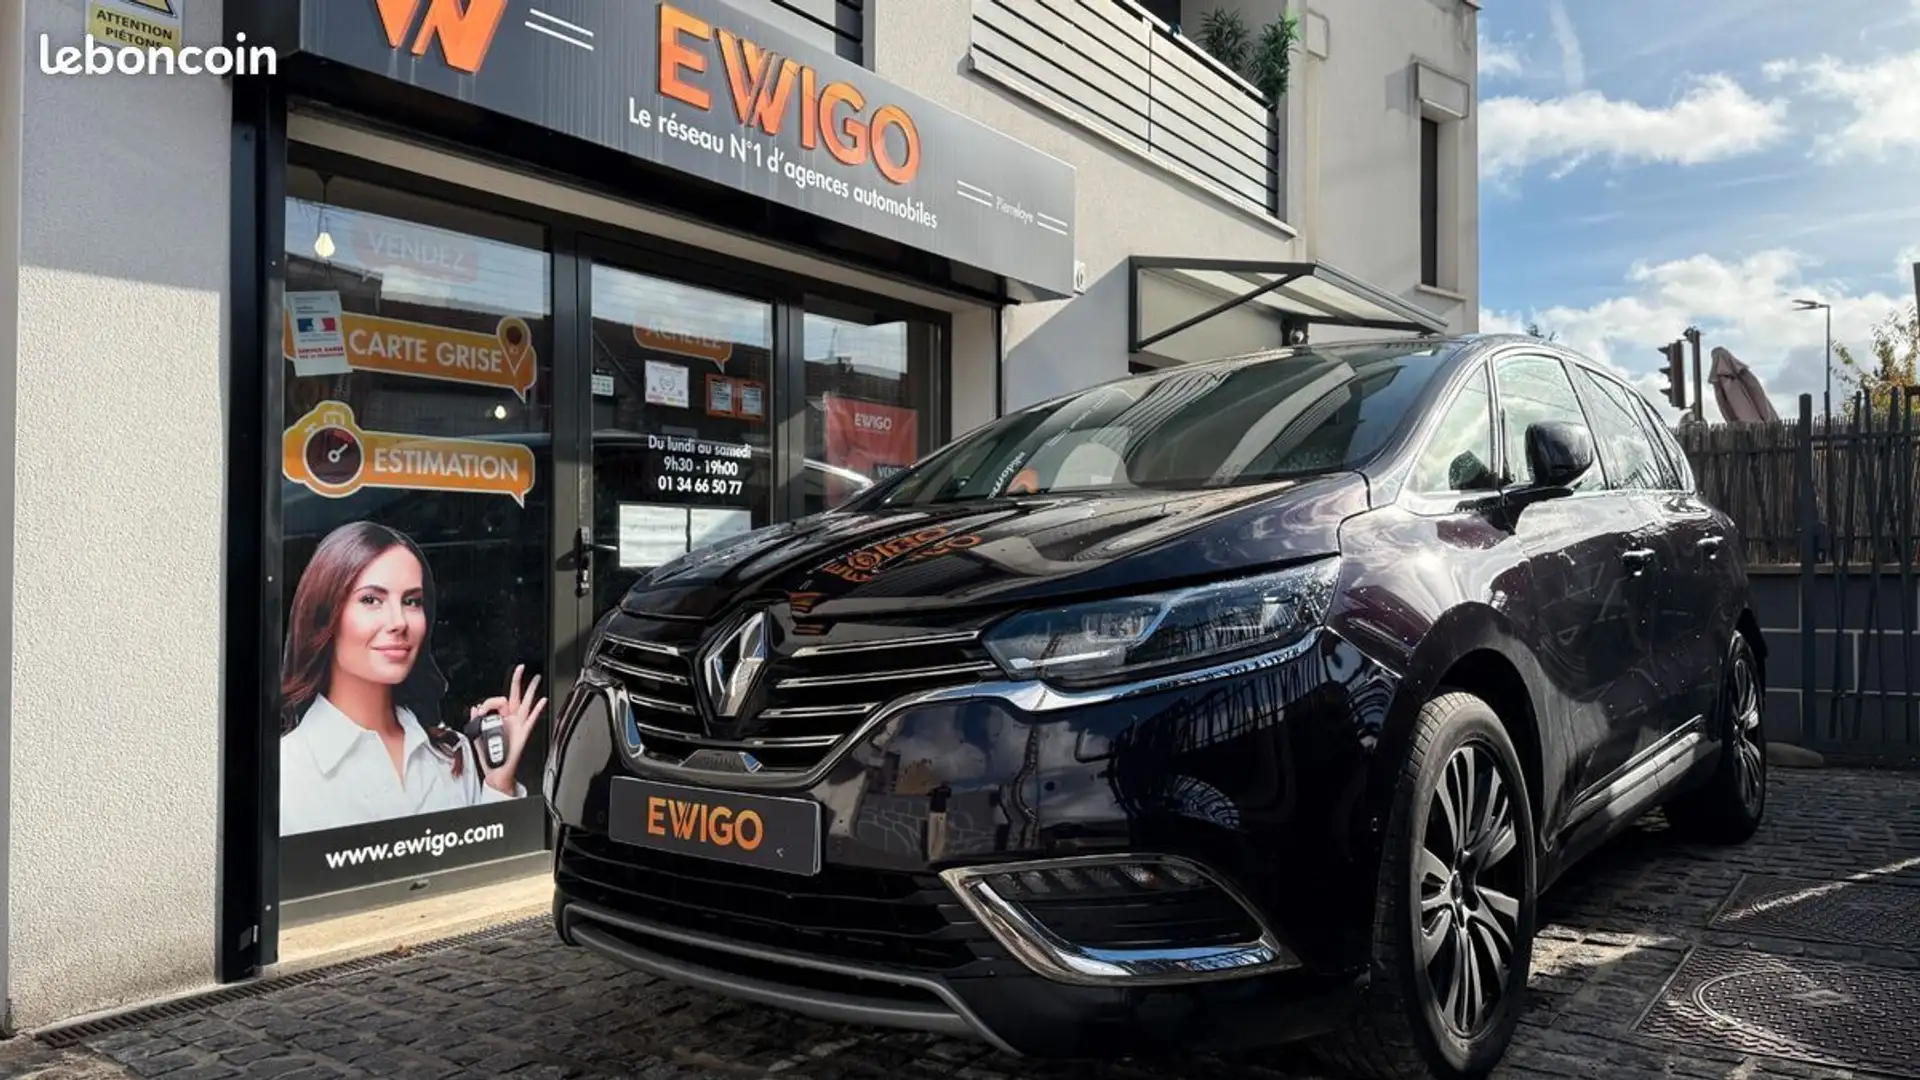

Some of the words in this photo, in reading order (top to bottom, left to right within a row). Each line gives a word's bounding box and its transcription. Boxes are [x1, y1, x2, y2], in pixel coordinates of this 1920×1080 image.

[96, 9, 173, 40] ATTENTION
[658, 3, 922, 184] EWIGO
[629, 97, 651, 128] Le
[658, 112, 724, 154] réseau
[766, 148, 849, 198] d'agences
[853, 186, 938, 229] automobiles
[366, 230, 466, 272] VENDEZ
[350, 329, 428, 363] CARTE
[436, 342, 503, 373] GRISE
[854, 413, 893, 431] EWIGO
[373, 447, 519, 482] ESTIMATION
[648, 434, 664, 449] Du
[667, 435, 695, 453] lundi
[697, 444, 712, 455] au
[715, 443, 752, 459] samedi
[664, 455, 694, 472] 9h30
[704, 459, 739, 476] 19h00
[657, 475, 673, 491] 01
[676, 476, 692, 492] 34
[694, 478, 710, 493] 66
[712, 478, 727, 495] 50
[728, 480, 743, 496] 77
[647, 796, 764, 850] EWIGO
[325, 823, 505, 869] www.ewigo.com
